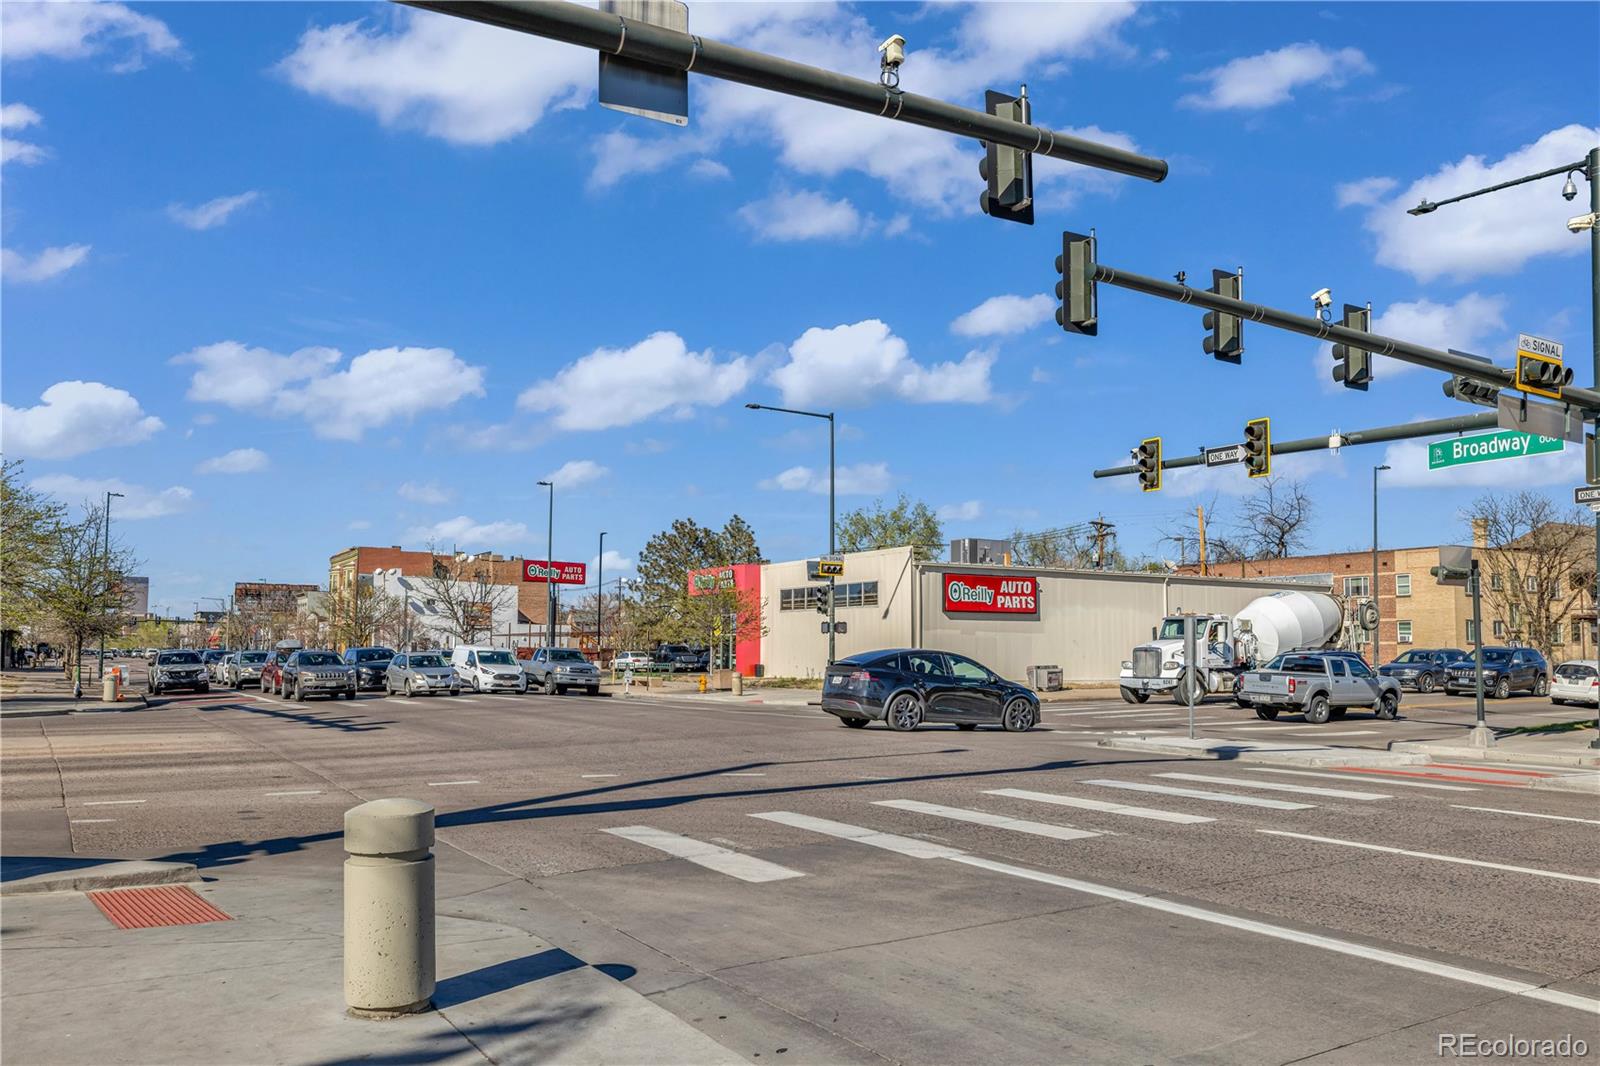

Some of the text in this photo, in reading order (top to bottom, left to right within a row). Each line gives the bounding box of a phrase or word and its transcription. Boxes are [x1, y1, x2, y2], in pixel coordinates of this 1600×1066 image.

[1532, 340, 1560, 357] SIGNAL
[1453, 435, 1531, 458] Broadway
[1210, 450, 1239, 461] ONE WAY
[1580, 491, 1594, 499] ONE
[528, 564, 560, 579] O'Relly
[562, 573, 583, 581] PARTS
[948, 580, 995, 605] O'Reilly
[1000, 581, 1032, 594] AUTO
[996, 595, 1036, 609] PARTS
